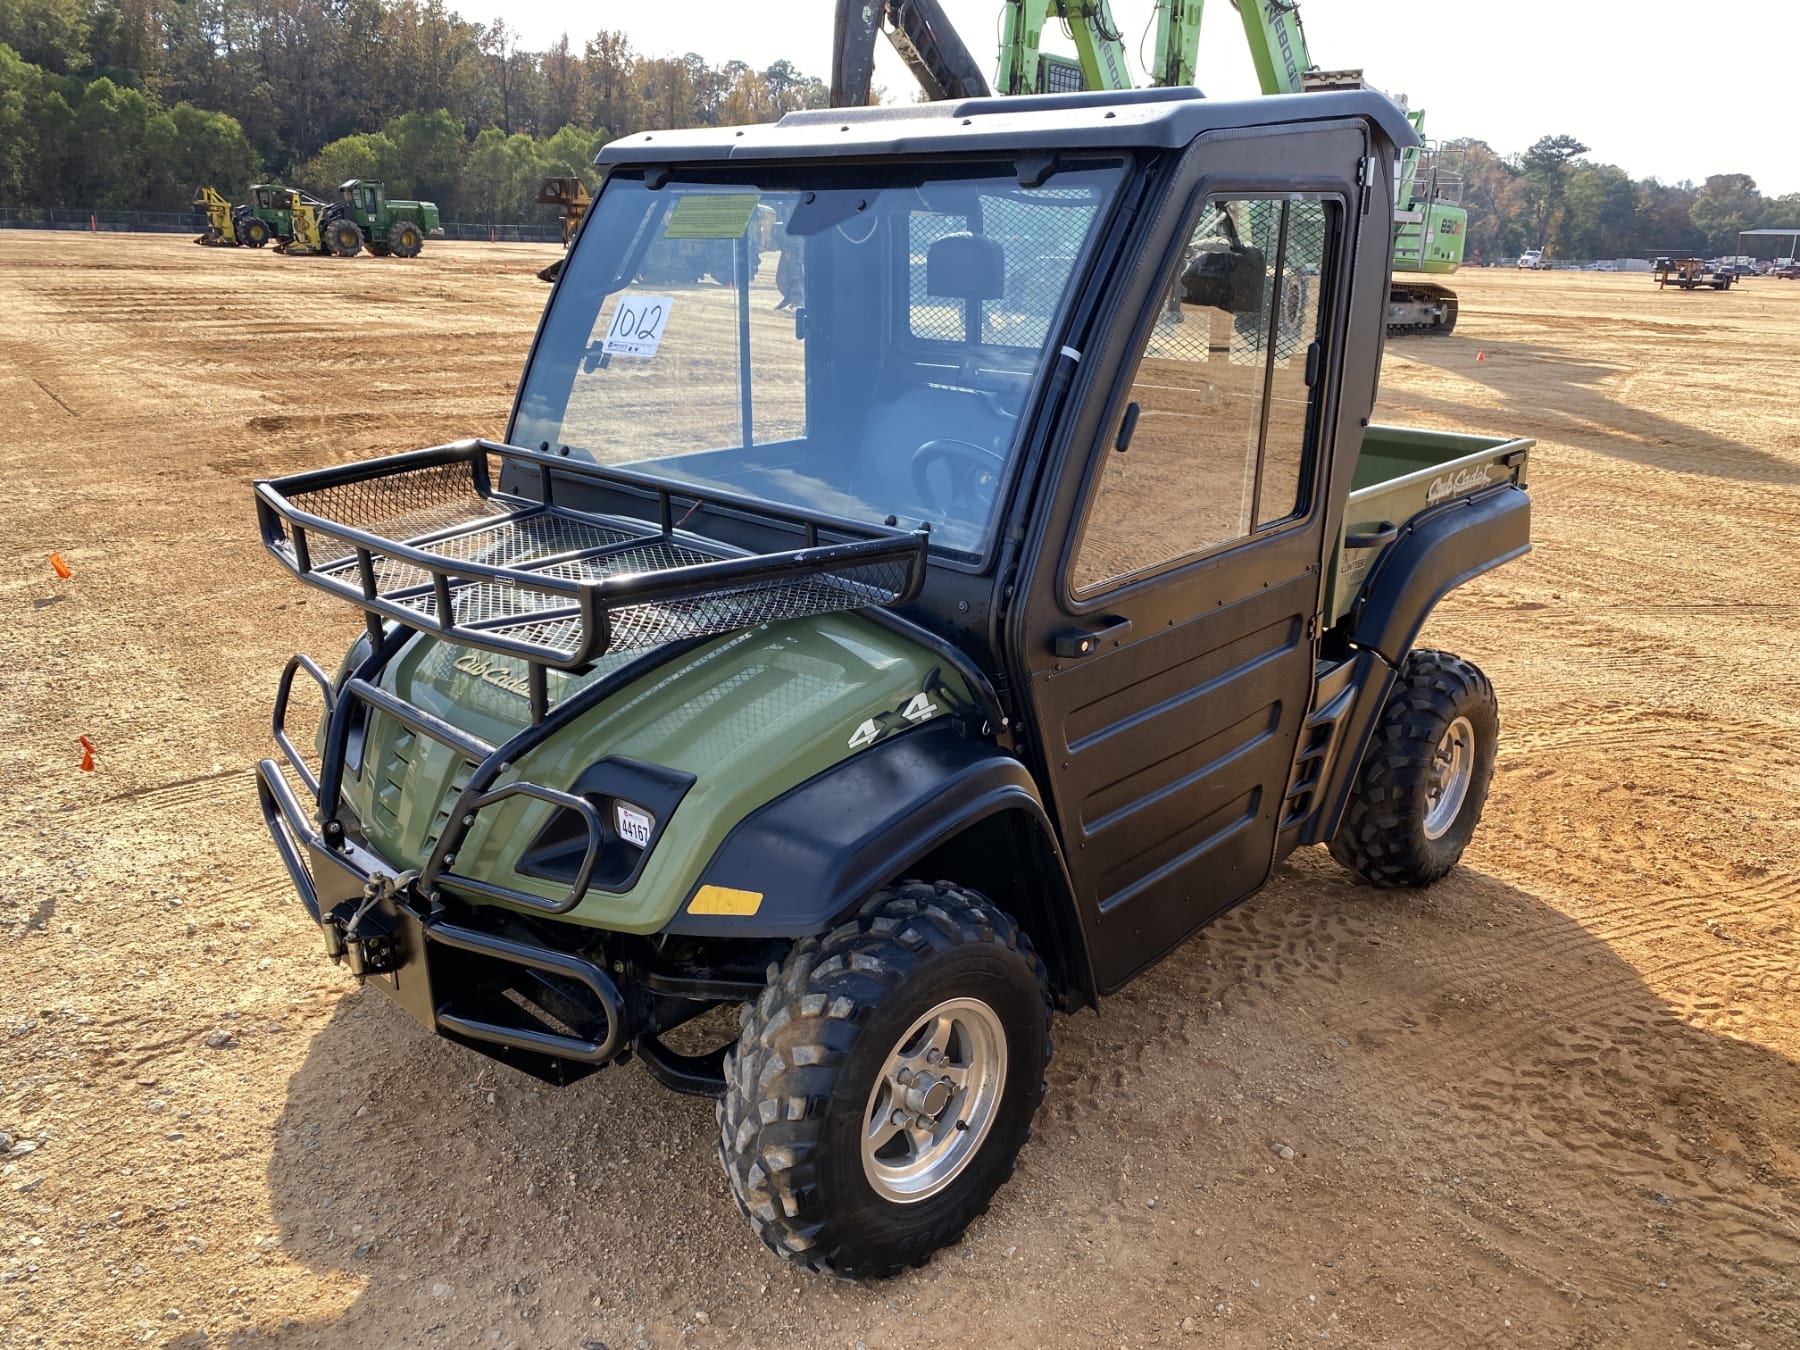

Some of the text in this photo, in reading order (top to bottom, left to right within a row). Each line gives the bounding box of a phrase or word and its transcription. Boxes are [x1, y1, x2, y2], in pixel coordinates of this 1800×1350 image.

[610, 302, 662, 340] 1012
[1427, 462, 1494, 502] Cub Cadet
[452, 655, 530, 698] Cub Cade
[622, 819, 648, 842] 44167
